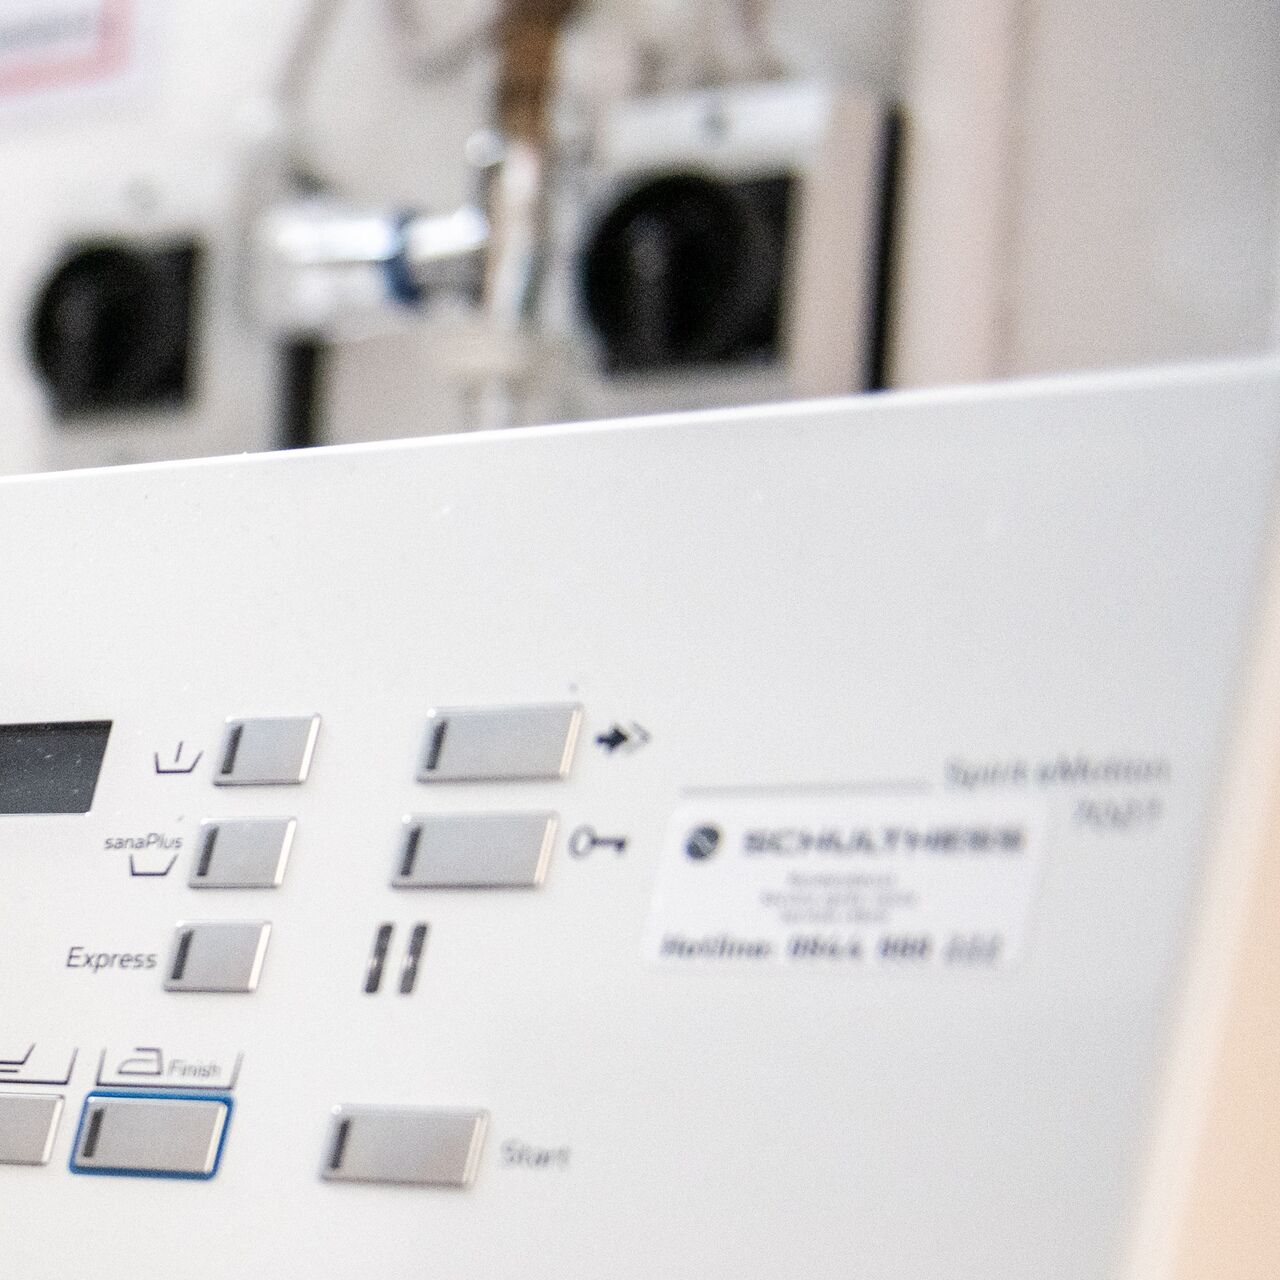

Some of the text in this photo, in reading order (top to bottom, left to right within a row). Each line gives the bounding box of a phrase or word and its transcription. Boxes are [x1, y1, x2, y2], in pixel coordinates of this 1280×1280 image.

[104, 832, 183, 850] sanaPlus
[742, 826, 1025, 857] SCHULTHESS
[66, 946, 158, 975] Express
[167, 1058, 221, 1078] Finish
